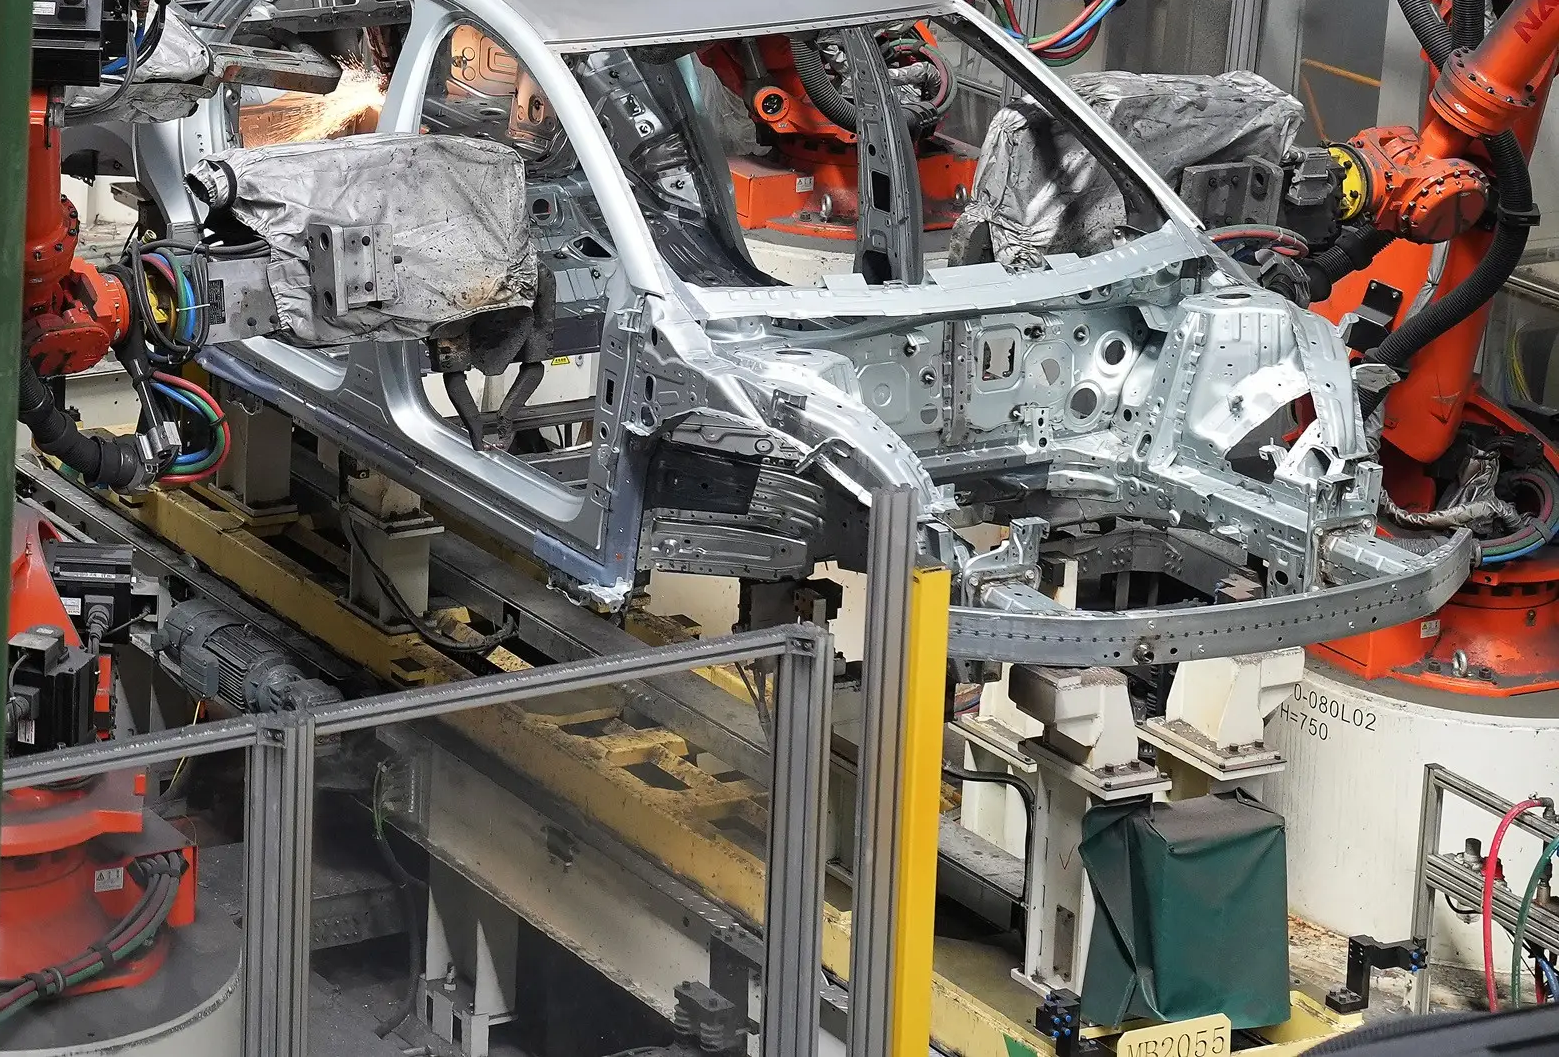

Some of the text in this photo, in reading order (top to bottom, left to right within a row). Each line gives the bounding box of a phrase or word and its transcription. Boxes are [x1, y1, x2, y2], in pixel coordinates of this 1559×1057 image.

[1280, 701, 1329, 741] H=750
[1294, 683, 1377, 732] 0-080L02
[1127, 1026, 1226, 1057] MB2055
